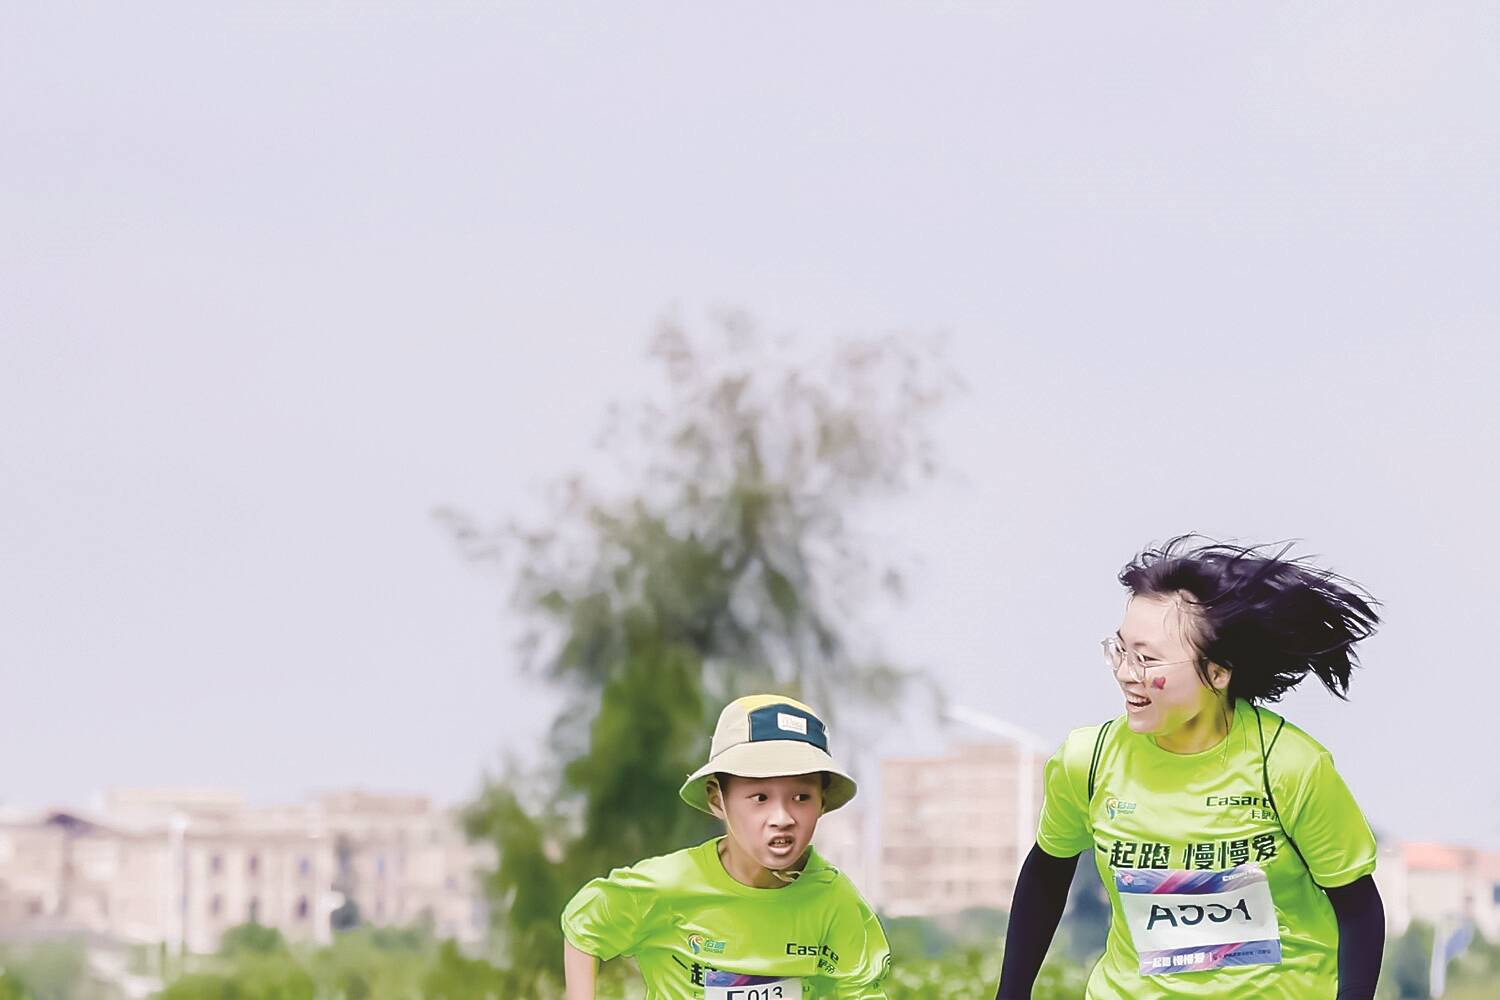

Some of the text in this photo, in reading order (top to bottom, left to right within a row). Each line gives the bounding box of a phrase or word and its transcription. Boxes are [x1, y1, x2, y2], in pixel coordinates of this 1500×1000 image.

[1097, 835, 1276, 870] 一起跑 慢慢爱
